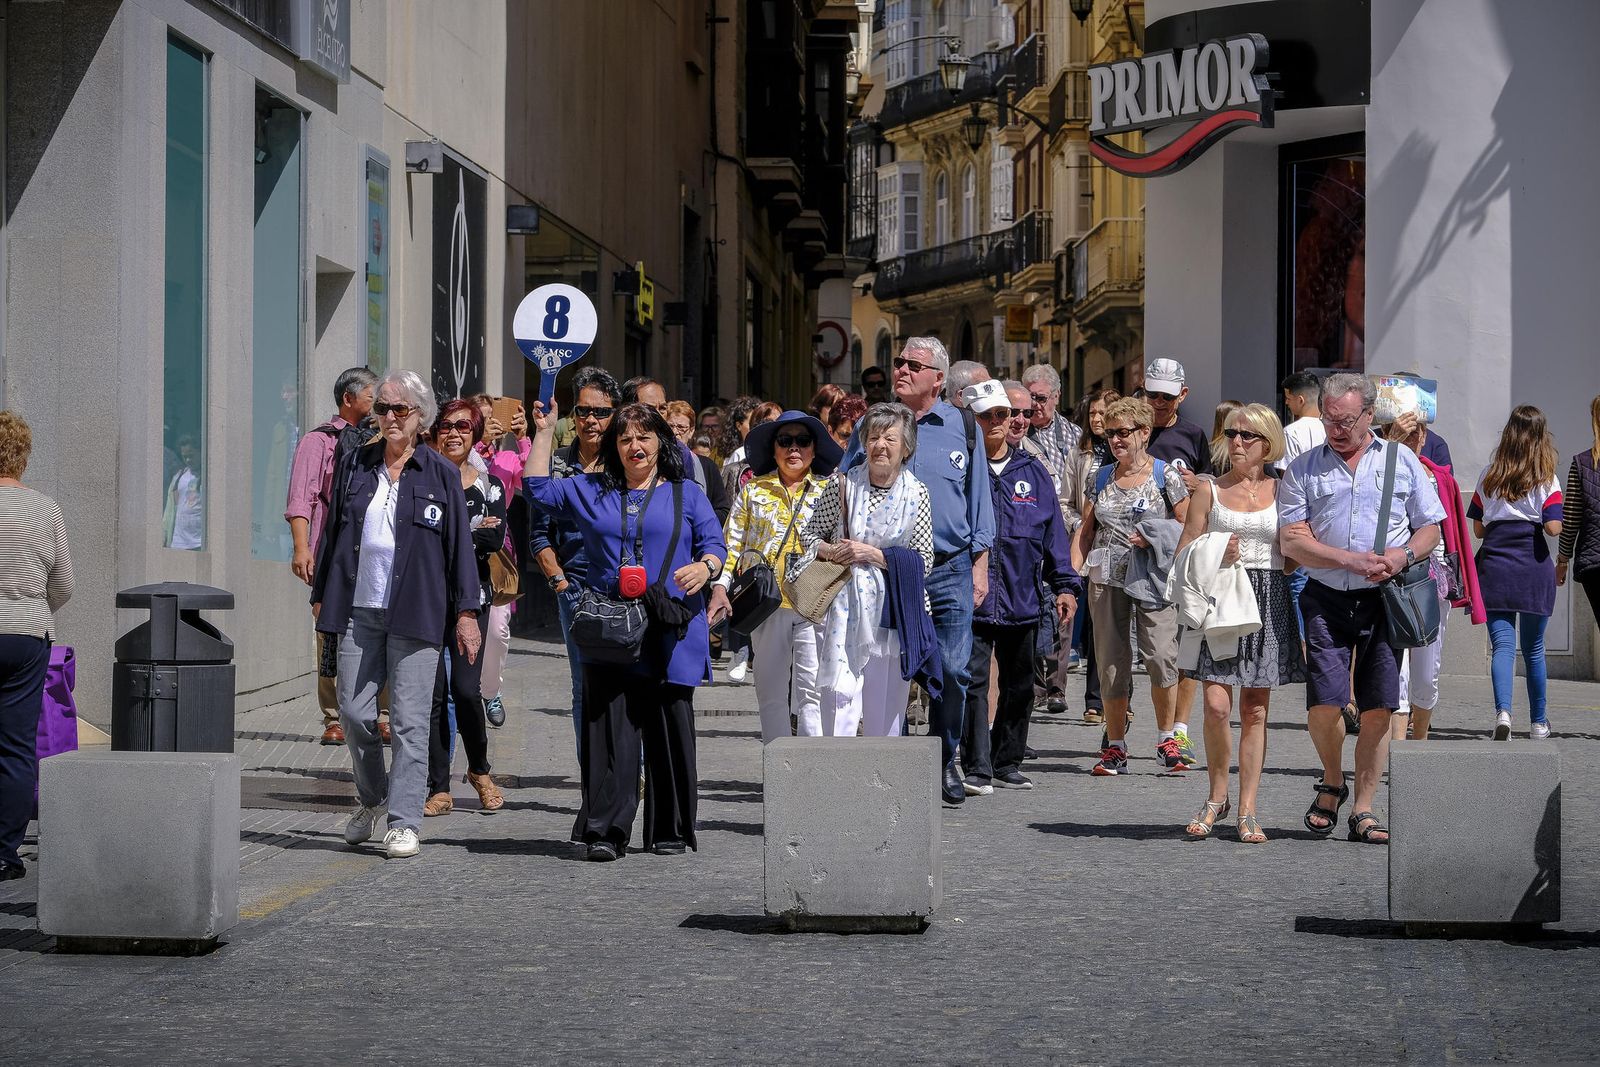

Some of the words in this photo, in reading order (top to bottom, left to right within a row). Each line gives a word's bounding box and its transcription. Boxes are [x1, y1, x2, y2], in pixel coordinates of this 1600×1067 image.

[1087, 37, 1261, 132] PRIMOR
[542, 294, 571, 340] 8
[549, 347, 573, 358] MSC
[547, 356, 554, 367] 8
[955, 454, 962, 463] 8
[1020, 483, 1026, 492] 8
[1138, 499, 1145, 507] 8
[430, 507, 437, 519] 8
